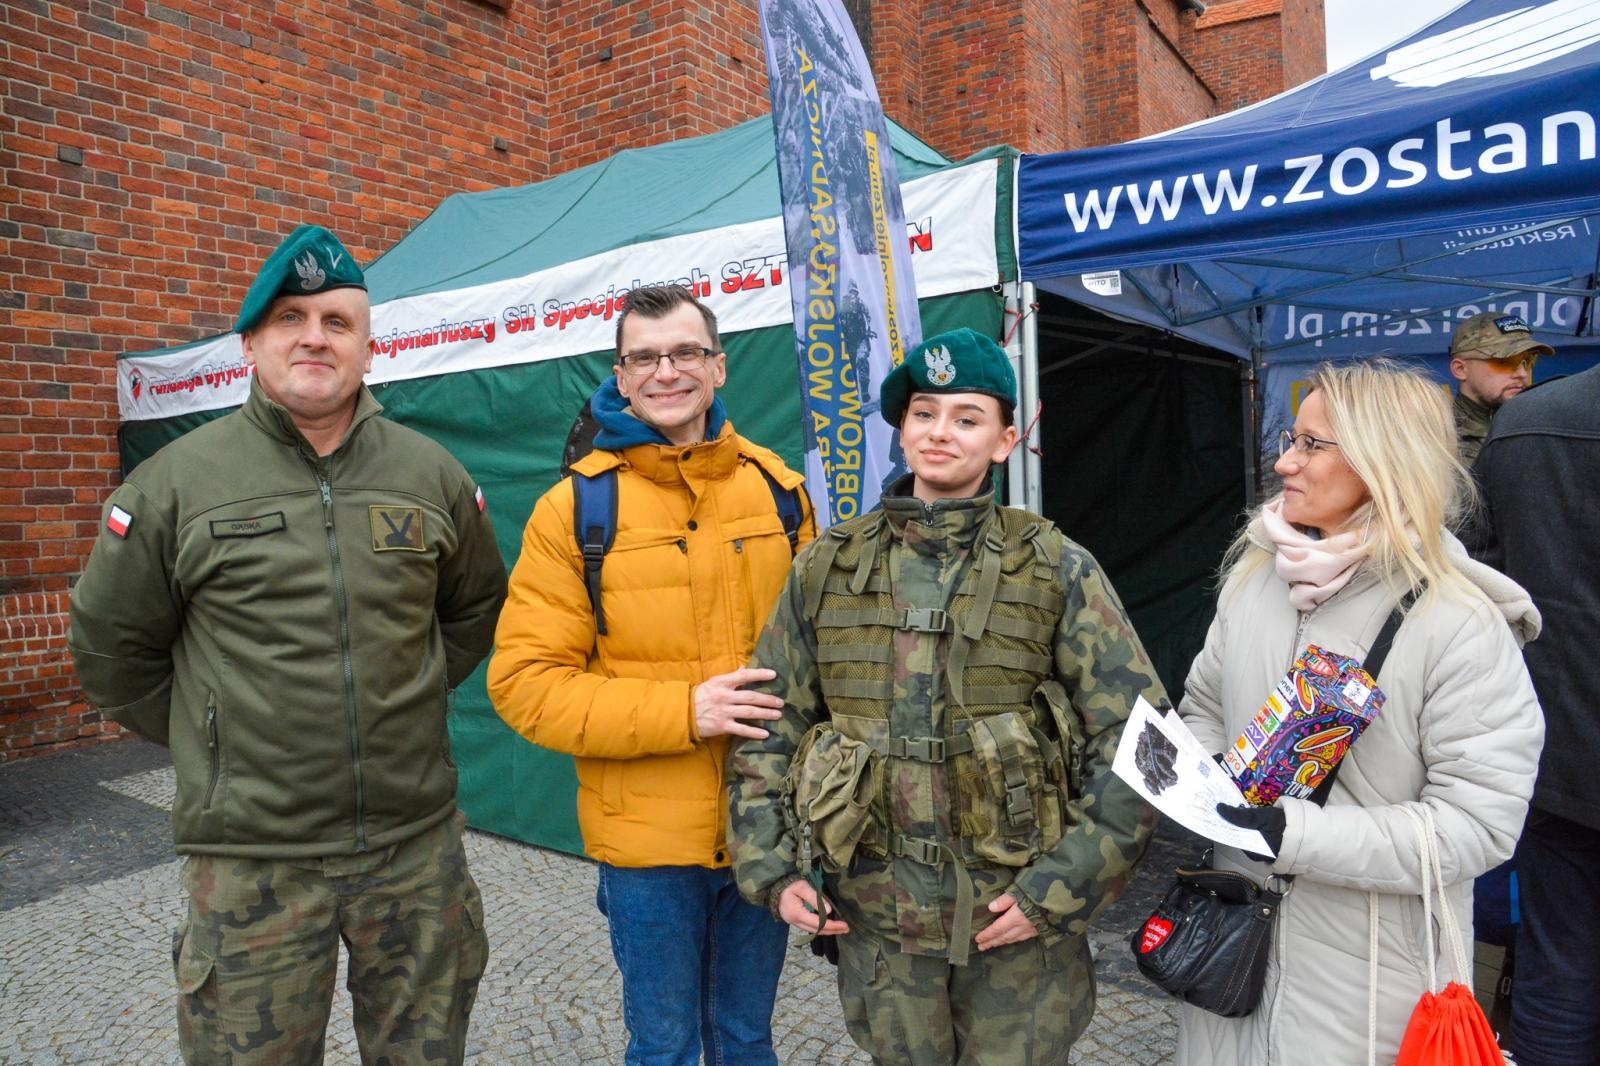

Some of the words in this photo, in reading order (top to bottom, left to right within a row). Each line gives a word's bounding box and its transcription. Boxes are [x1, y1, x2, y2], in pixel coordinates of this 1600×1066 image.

[1064, 110, 1596, 233] www.zostan
[371, 316, 497, 358] kcjonariuszy
[502, 299, 537, 334] Sił
[543, 268, 711, 330] Specjach
